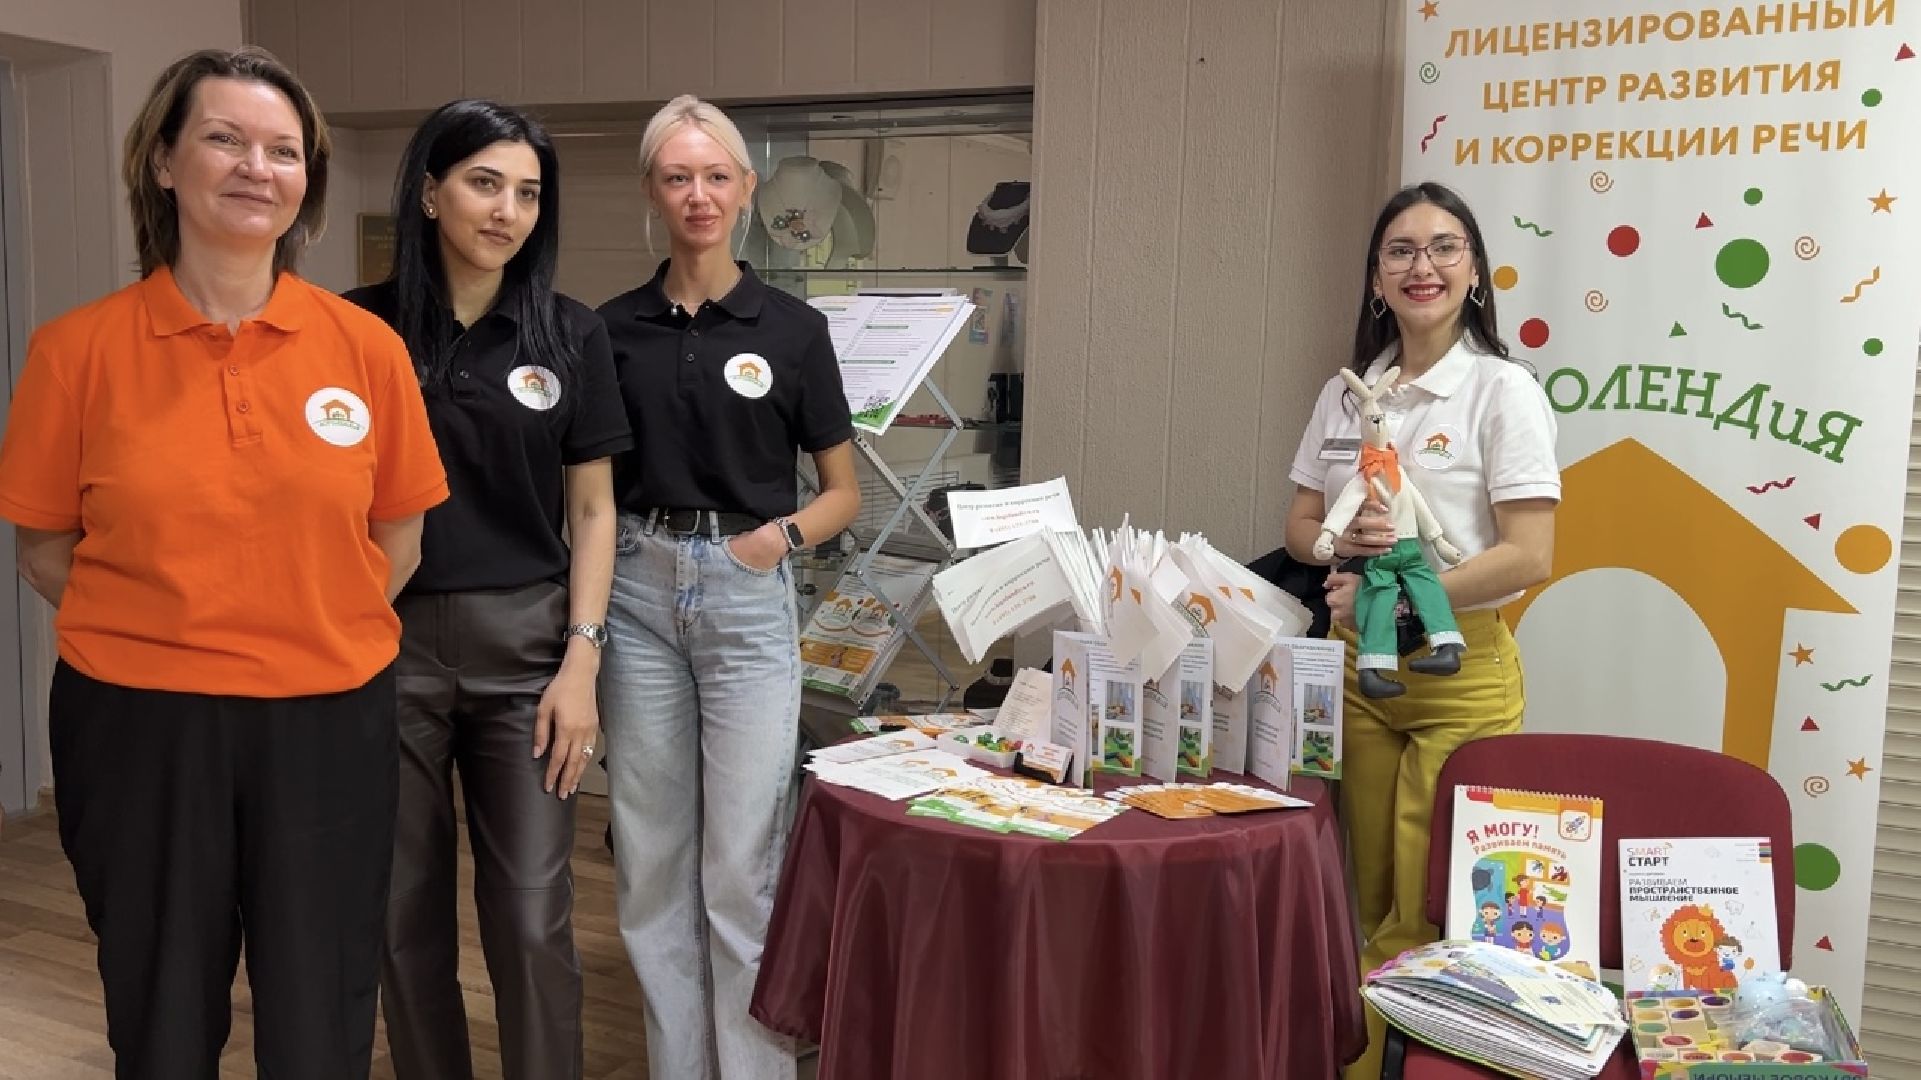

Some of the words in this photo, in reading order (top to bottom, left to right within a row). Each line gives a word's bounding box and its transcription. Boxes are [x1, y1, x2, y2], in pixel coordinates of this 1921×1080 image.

[1444, 0, 1897, 58] ЛИЦЕНЗИРОВАННЫЙ
[1482, 74, 1607, 112] ЦЕНТР
[1618, 59, 1841, 101] РАЗВИТИЯ
[1454, 138, 1480, 166] И
[1491, 126, 1739, 163] КОРРЕКЦИИ
[1752, 119, 1868, 154] РЕЧИ
[1466, 829, 1480, 845] Я
[1483, 822, 1540, 839] МОГУ!
[1626, 847, 1668, 856] SMART
[1628, 856, 1670, 867] СТАРТ
[1629, 886, 1740, 895] ПРОСТРАНСТВЕННОЕ
